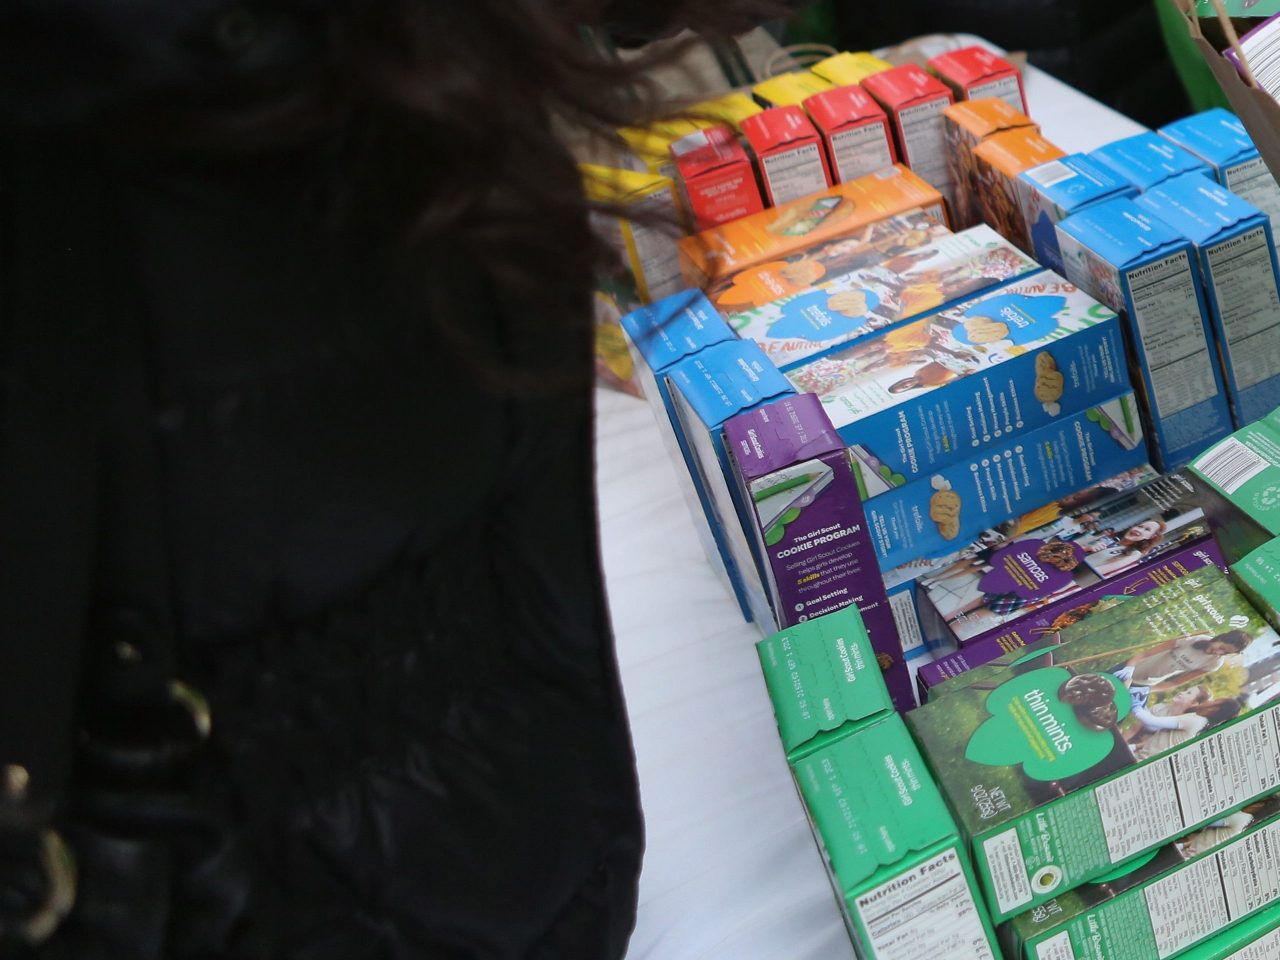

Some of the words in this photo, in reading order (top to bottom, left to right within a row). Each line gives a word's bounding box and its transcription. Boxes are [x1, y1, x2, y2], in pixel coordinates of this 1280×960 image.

[1207, 238, 1241, 255] Nutrition
[1243, 229, 1263, 241] Facts
[1127, 262, 1163, 280] Nutrition
[1164, 252, 1186, 265] Facts
[897, 409, 913, 447] PROGRAM
[906, 446, 919, 473] COOKIE
[1072, 420, 1085, 448] COOKIE
[1079, 447, 1092, 481] PROGRAM
[910, 504, 924, 530] trefoils
[776, 540, 814, 560] COOKIE
[812, 523, 861, 546] PROGRAM
[793, 534, 808, 544] The
[807, 529, 821, 539] Girl
[820, 522, 840, 534] Scout
[785, 558, 807, 571] Selling
[806, 554, 818, 564] Girl
[817, 548, 836, 560] Scout
[835, 539, 860, 553] Cookies
[797, 564, 816, 576] helps
[814, 559, 829, 570] girls
[827, 551, 853, 565] develop
[1015, 550, 1050, 583] samoas
[1192, 549, 1207, 560] girl
[802, 571, 820, 583] skills
[819, 567, 833, 577] that
[832, 562, 847, 572] they
[846, 557, 859, 567] use
[1183, 577, 1201, 590] girl
[805, 596, 822, 607] Goal
[821, 586, 848, 601] Setting
[808, 603, 839, 619] Decision
[838, 594, 864, 608] Making
[1191, 592, 1211, 607] girl
[1203, 603, 1226, 624] scouts
[835, 636, 849, 658] Cookies
[841, 656, 853, 673] Scout
[845, 670, 856, 682] Girl
[854, 657, 865, 670] thin
[1022, 686, 1054, 716] thin
[1037, 710, 1077, 753] mints
[882, 753, 901, 778] Cookies
[892, 776, 908, 794] Scout
[969, 782, 984, 793] 9
[972, 787, 988, 802] OZ
[988, 785, 1005, 802] NET
[900, 792, 913, 806] Girl
[973, 795, 998, 821] (255g)
[994, 797, 1011, 813] WT
[1035, 810, 1047, 834] Little
[858, 871, 917, 908] Nutrition
[919, 850, 956, 876] Facts
